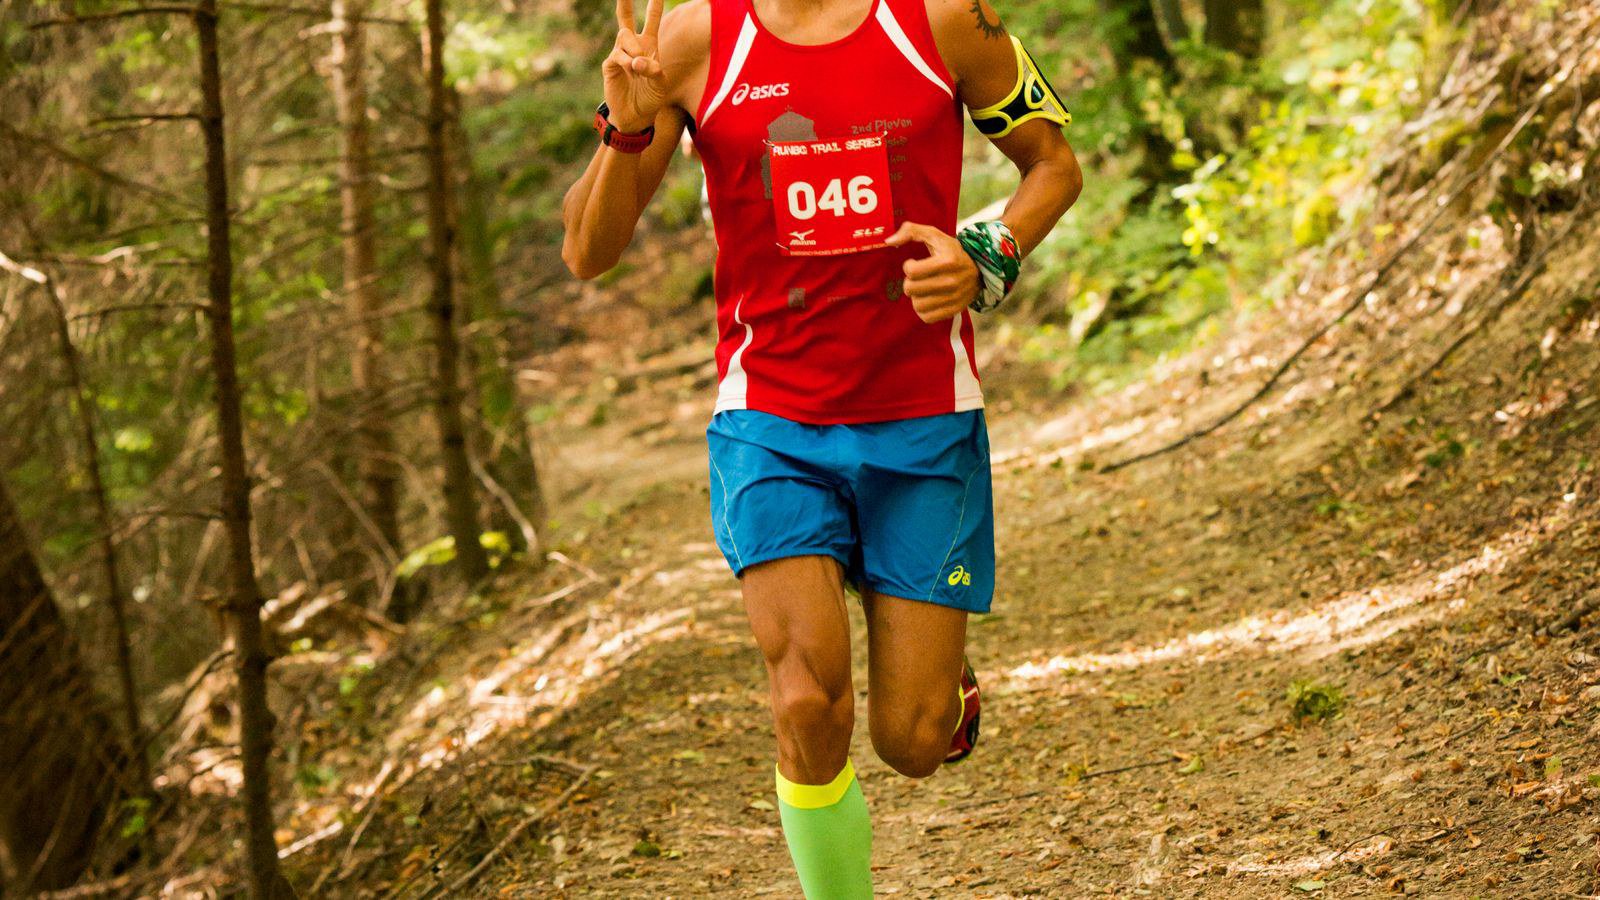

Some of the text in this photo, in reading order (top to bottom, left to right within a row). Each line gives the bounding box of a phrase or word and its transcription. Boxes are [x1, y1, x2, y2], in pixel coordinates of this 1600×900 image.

[750, 83, 789, 100] asics
[851, 118, 912, 134] 2nd Pleven
[772, 145, 807, 156] RUNBG
[811, 142, 841, 154] TRAIL
[787, 175, 878, 220] 046
[852, 226, 884, 238] SLS
